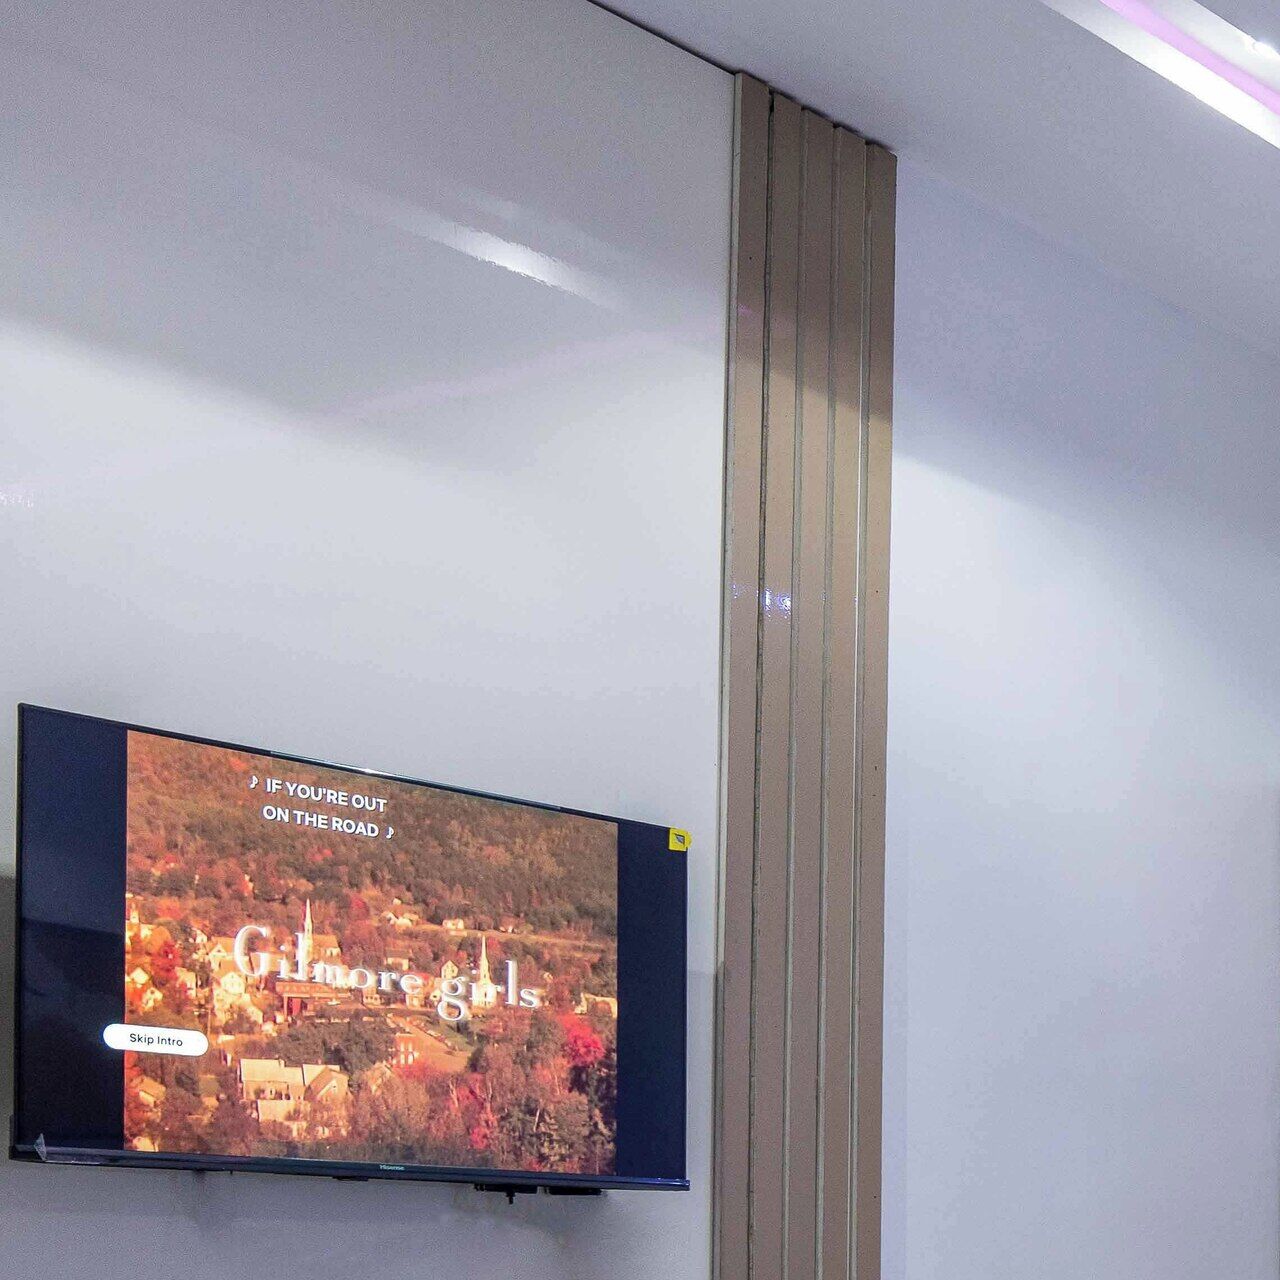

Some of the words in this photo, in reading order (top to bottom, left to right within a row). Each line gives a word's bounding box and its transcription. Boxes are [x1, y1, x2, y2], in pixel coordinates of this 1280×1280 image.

[266, 778, 282, 793] IF
[285, 781, 348, 806] YOU'RE
[351, 794, 388, 813] OUT
[262, 805, 289, 823] ON
[293, 810, 328, 829] THE
[331, 817, 379, 837] ROAD
[234, 925, 422, 994] Gilmore
[437, 960, 540, 1020] girls
[129, 1033, 154, 1046] Skip
[157, 1036, 183, 1047] Intro
